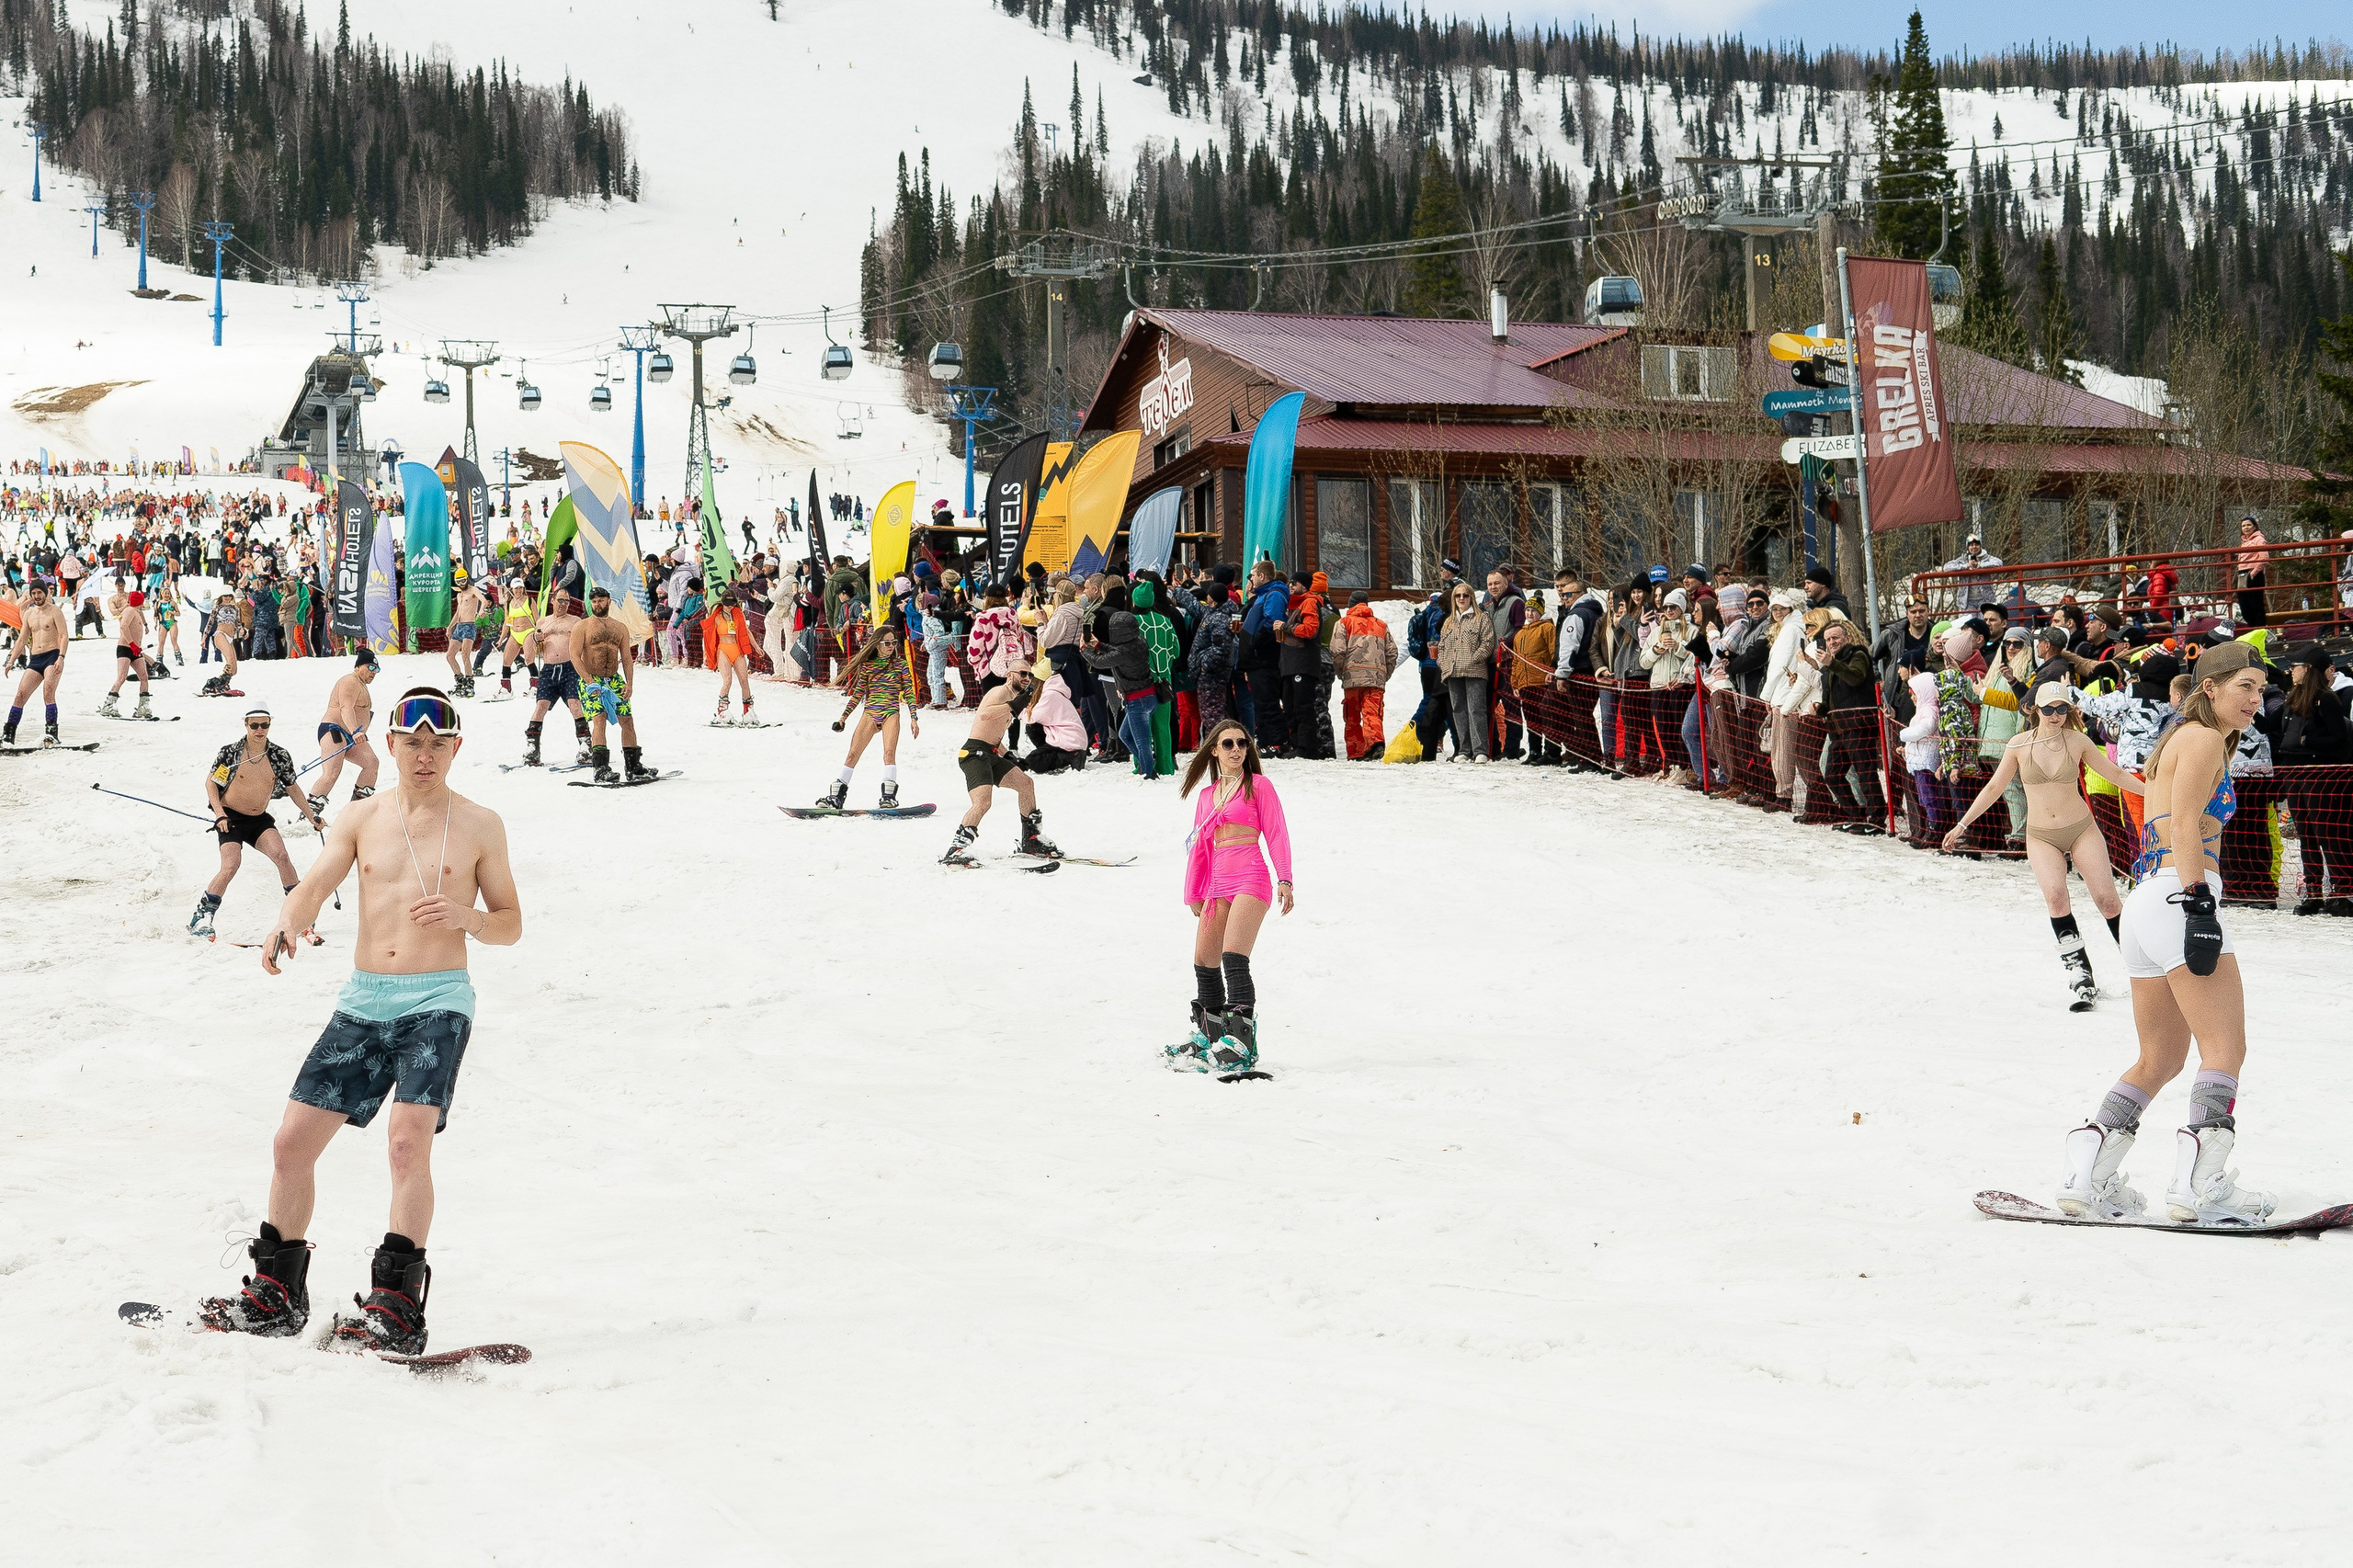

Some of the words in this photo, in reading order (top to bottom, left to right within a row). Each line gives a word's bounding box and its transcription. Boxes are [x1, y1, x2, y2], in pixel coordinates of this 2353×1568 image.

[1754, 254, 1771, 267] 13
[1051, 292, 1063, 301] 14
[1916, 347, 1927, 368] BAR
[1920, 369, 1931, 387] SKI
[1873, 324, 1924, 455] GRELKA
[1770, 397, 1824, 411] Mammoth
[1923, 389, 1936, 423] APRES
[997, 481, 1022, 574] HOTELS
[408, 572, 443, 580] ДИРЕКЦИЯ
